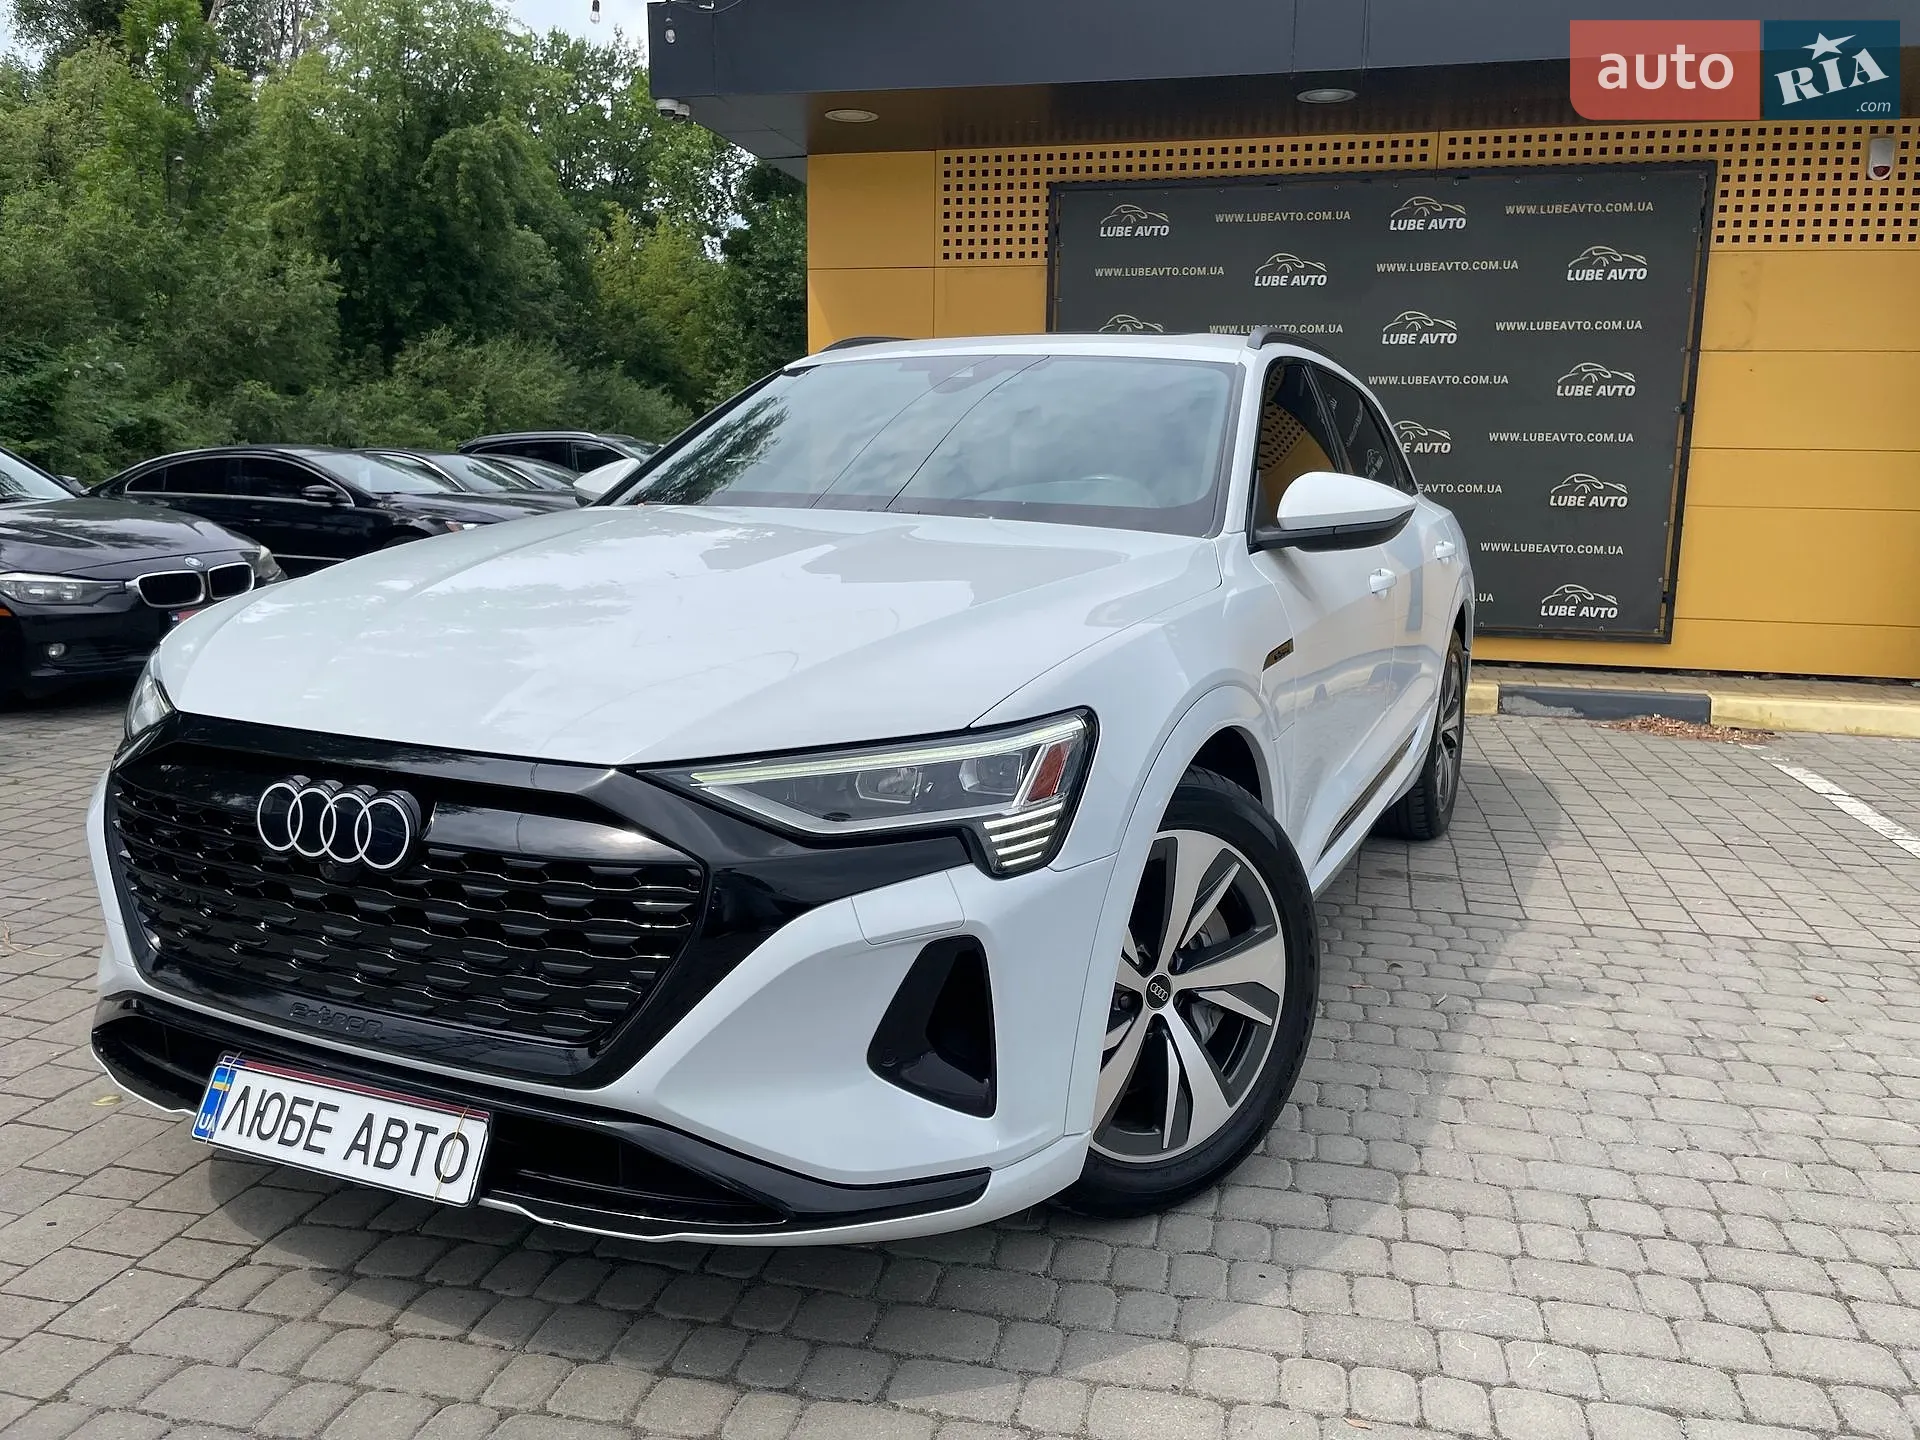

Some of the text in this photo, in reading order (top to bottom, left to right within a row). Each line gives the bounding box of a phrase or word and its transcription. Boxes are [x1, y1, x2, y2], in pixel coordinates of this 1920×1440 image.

[1505, 201, 1654, 215] WWW.LUBEAVTO.COM.UA
[1215, 210, 1351, 223] WWW.LUBEAVTO.COM.UA
[1389, 217, 1467, 231] LUBE AVTO
[1100, 225, 1169, 237] LUBE AVTO
[1095, 266, 1224, 277] WWW.LUBEAVTO.COM.UA
[1376, 259, 1519, 273] WWW.LUBEAVTO.COM.UA
[1254, 274, 1327, 286] LUBE AVTO
[1567, 268, 1648, 281] LUBE AVTO
[1209, 324, 1344, 334] WWW.LUTO.COM.UA
[1495, 320, 1643, 331] WWW.LUBEAVTO.COM.UA
[1381, 332, 1457, 345] LUBE AVTO
[1368, 375, 1509, 386] WWW.LUBEAVTO.COM.UA
[1556, 385, 1636, 397] LUBE AVTO
[1488, 432, 1634, 443] WWW.LUBEAVTO.COM.UA
[1413, 442, 1451, 453] AVTO
[1549, 496, 1628, 508] LUBE AVTO
[1480, 542, 1624, 556] WWW.LUBEAVTO.COM.UA
[1540, 605, 1618, 619] LUBE AVTO
[290, 1001, 384, 1039] e-tron
[198, 1113, 216, 1133] UA
[221, 1085, 470, 1184] ЛЮБЕ АВТО
